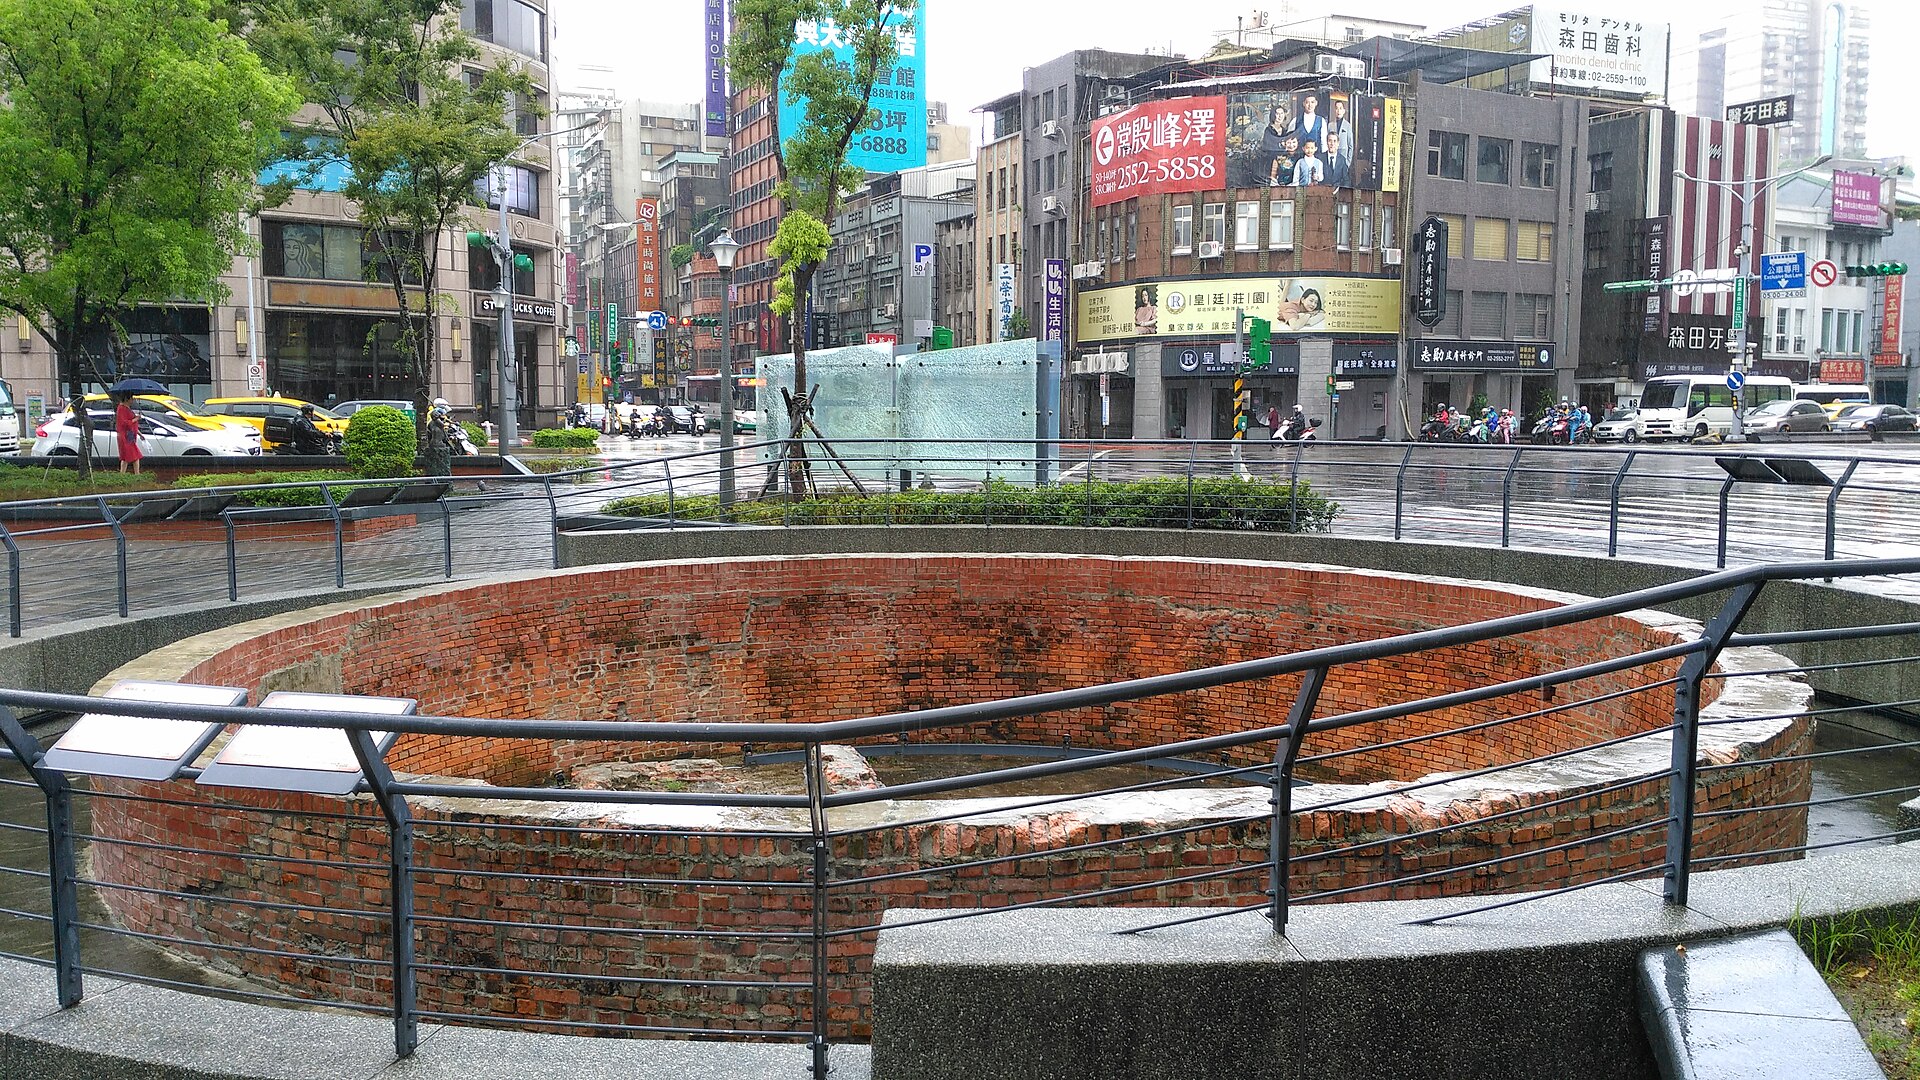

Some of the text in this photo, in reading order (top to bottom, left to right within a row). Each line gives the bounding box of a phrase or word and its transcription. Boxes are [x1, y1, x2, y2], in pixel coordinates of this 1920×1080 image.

[1560, 13, 1642, 32] モリタ デンタル
[1558, 27, 1642, 57] 森田齒科
[710, 31, 720, 92] HOTEL
[1556, 53, 1642, 72] morita dental clinic
[1116, 109, 1216, 158] 常殷峰澤
[1117, 155, 1216, 190] 2552-5858
[915, 245, 931, 262] P
[1767, 264, 1800, 275] 公車專用
[483, 301, 533, 314] STUCKS
